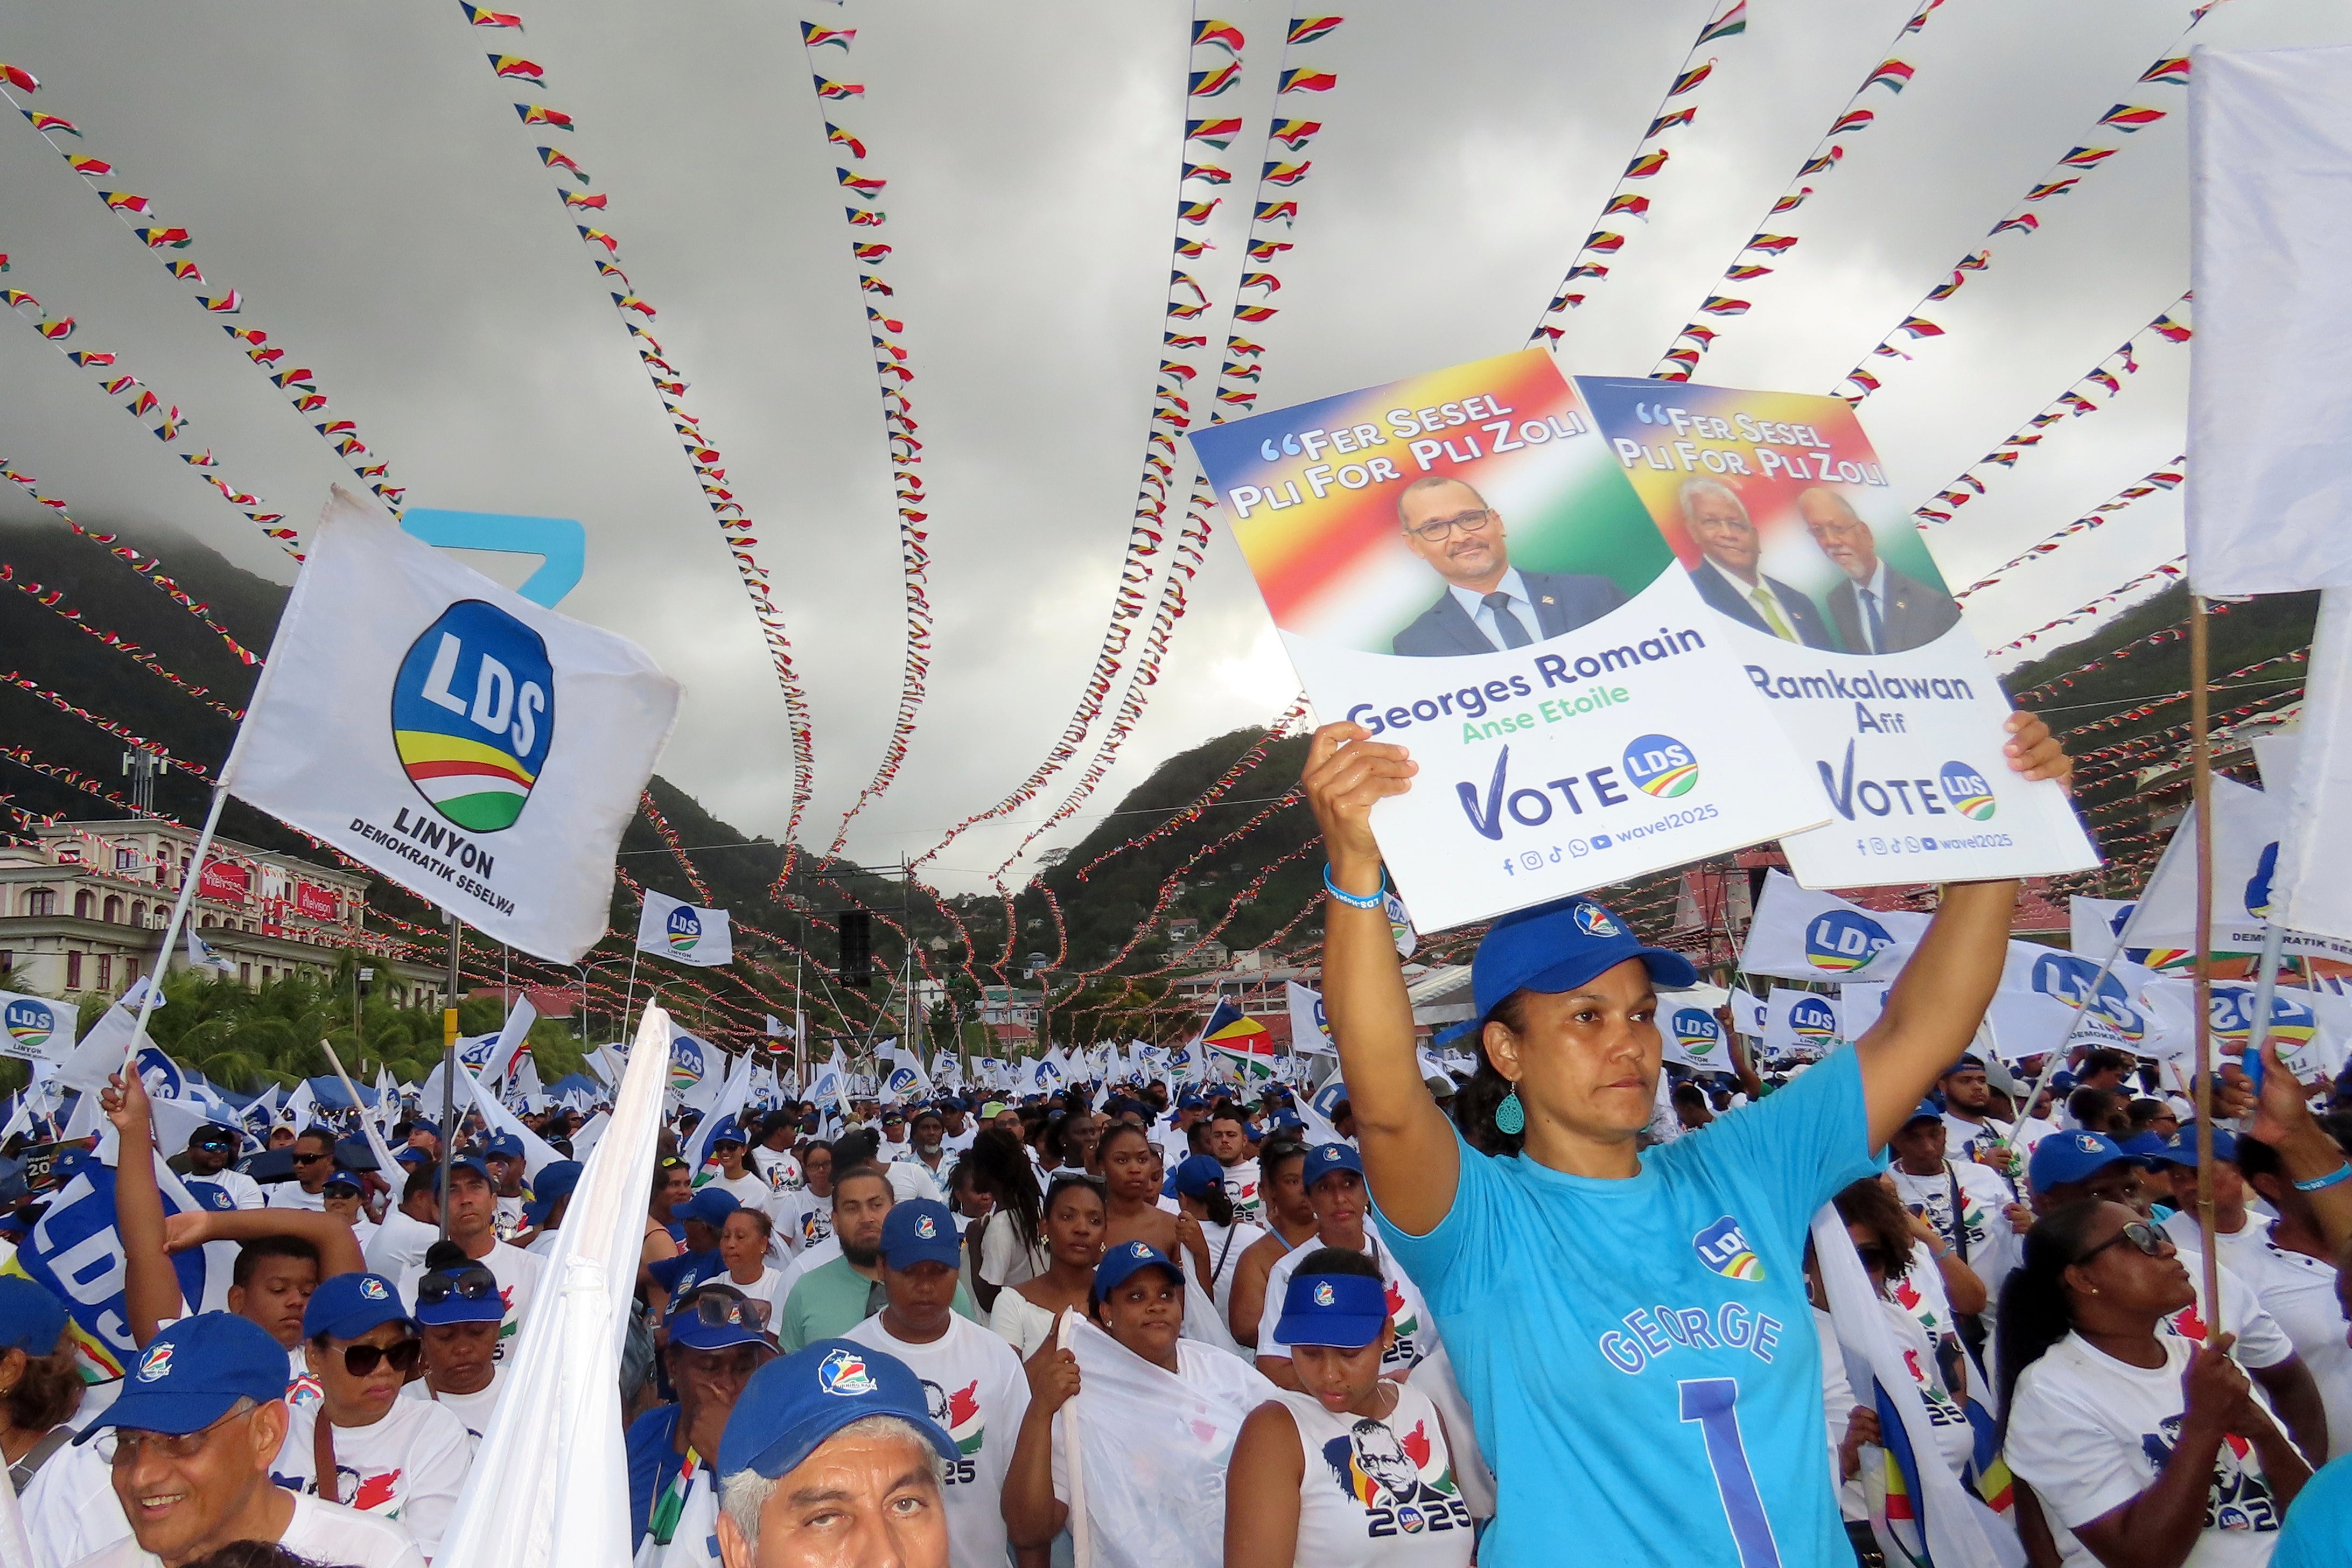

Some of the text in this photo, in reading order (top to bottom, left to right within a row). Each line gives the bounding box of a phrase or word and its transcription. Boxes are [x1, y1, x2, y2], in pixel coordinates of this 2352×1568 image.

[1385, 394, 1513, 439] SESEL
[1733, 412, 1832, 449] SESEL
[1228, 410, 1587, 520] PLI FOR PLI ZOLI
[1612, 437, 1889, 487] PLI FOR PLI ZOLI
[421, 631, 545, 757] LDS
[1346, 626, 1706, 736] Georges Romain
[1742, 664, 1975, 701] Ramkalawan
[1461, 685, 1630, 745] Anse Etoile
[1854, 701, 1907, 734] Afif
[1455, 743, 1690, 841] VOTE LDS
[1816, 736, 1990, 821] VOTE LDS
[393, 807, 494, 880] LINYON
[1616, 803, 1720, 843] wavel2025
[1941, 833, 2014, 850] wavel2025
[349, 817, 516, 918] DEMOKRATIK SESELWA
[670, 913, 698, 935] LDS
[2232, 932, 2327, 948] DEMRATIK
[10, 1006, 52, 1029] LDS
[1675, 1017, 1716, 1037] LDS
[1794, 1006, 1833, 1030] LDS
[12, 1043, 42, 1054] LINYON
[1599, 1301, 1783, 1375] GEORGE
